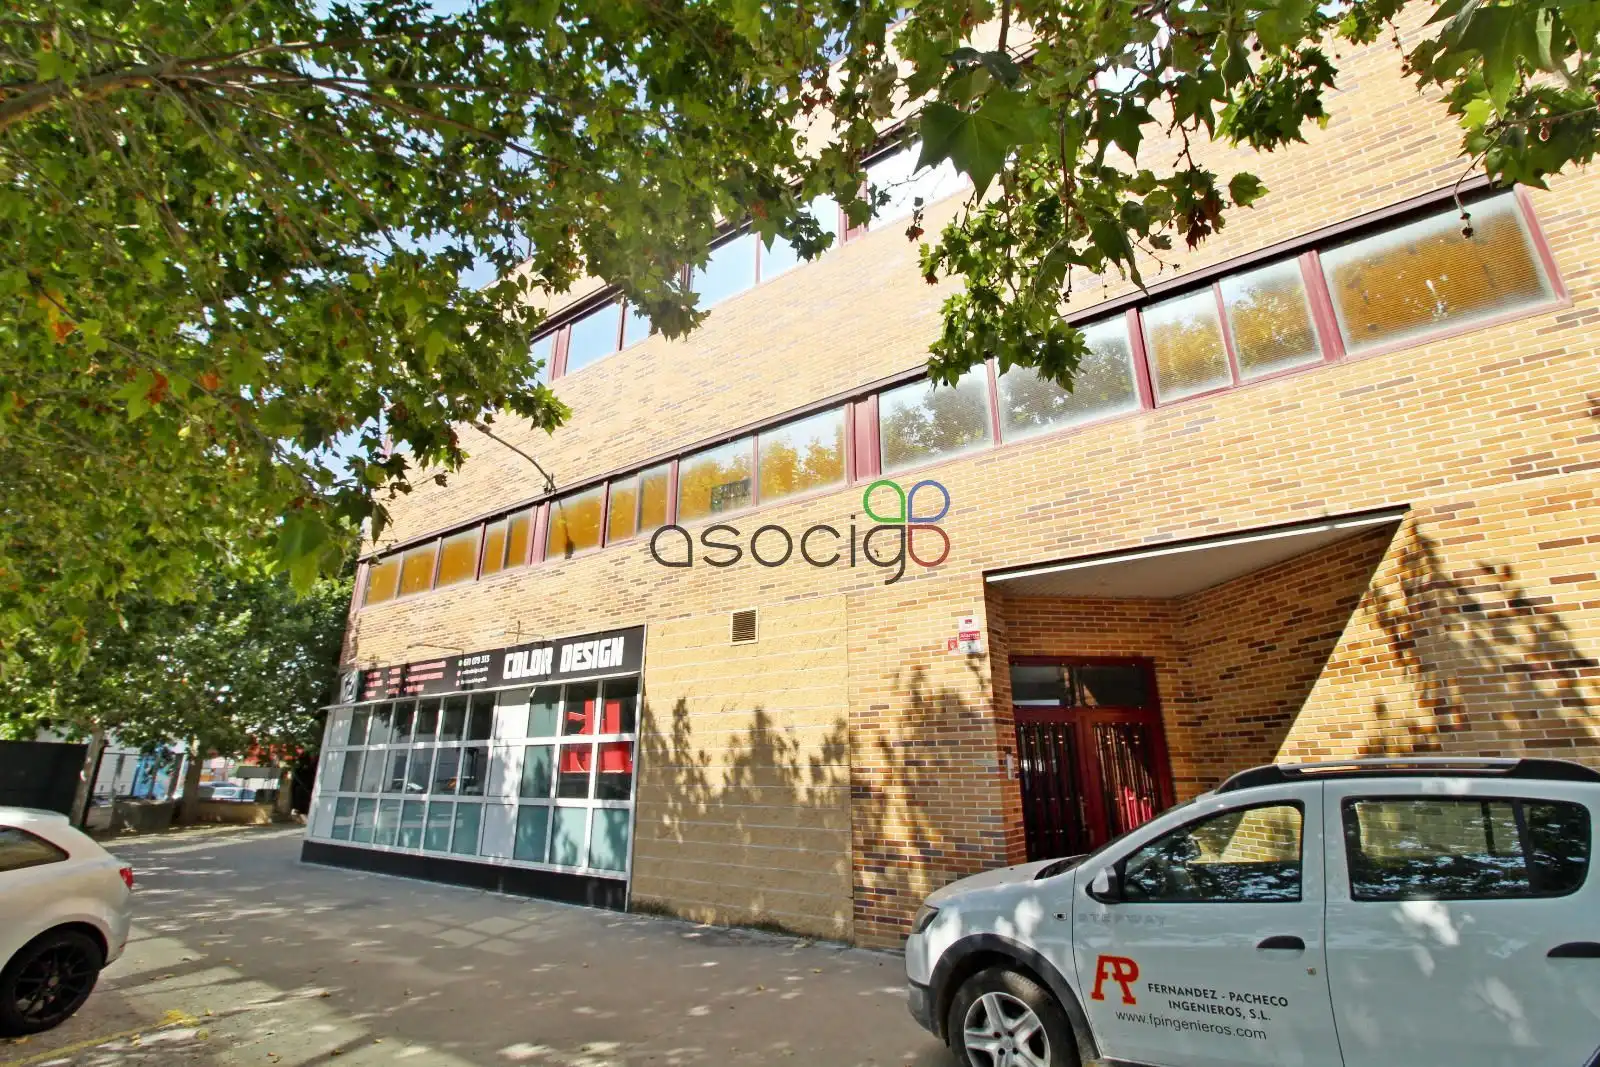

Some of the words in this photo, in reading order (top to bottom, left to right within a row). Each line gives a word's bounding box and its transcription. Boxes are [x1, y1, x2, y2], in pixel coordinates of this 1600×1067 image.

[503, 647, 554, 679] COLOR
[560, 637, 625, 672] DESIGN
[1147, 983, 1218, 1000] FERNANDEZ
[1229, 991, 1289, 1007] PACHECO
[1168, 1000, 1246, 1020] INGENIEROS,
[1249, 1008, 1272, 1021] S.L.
[1115, 1009, 1268, 1041] www.fpingenieros.com
